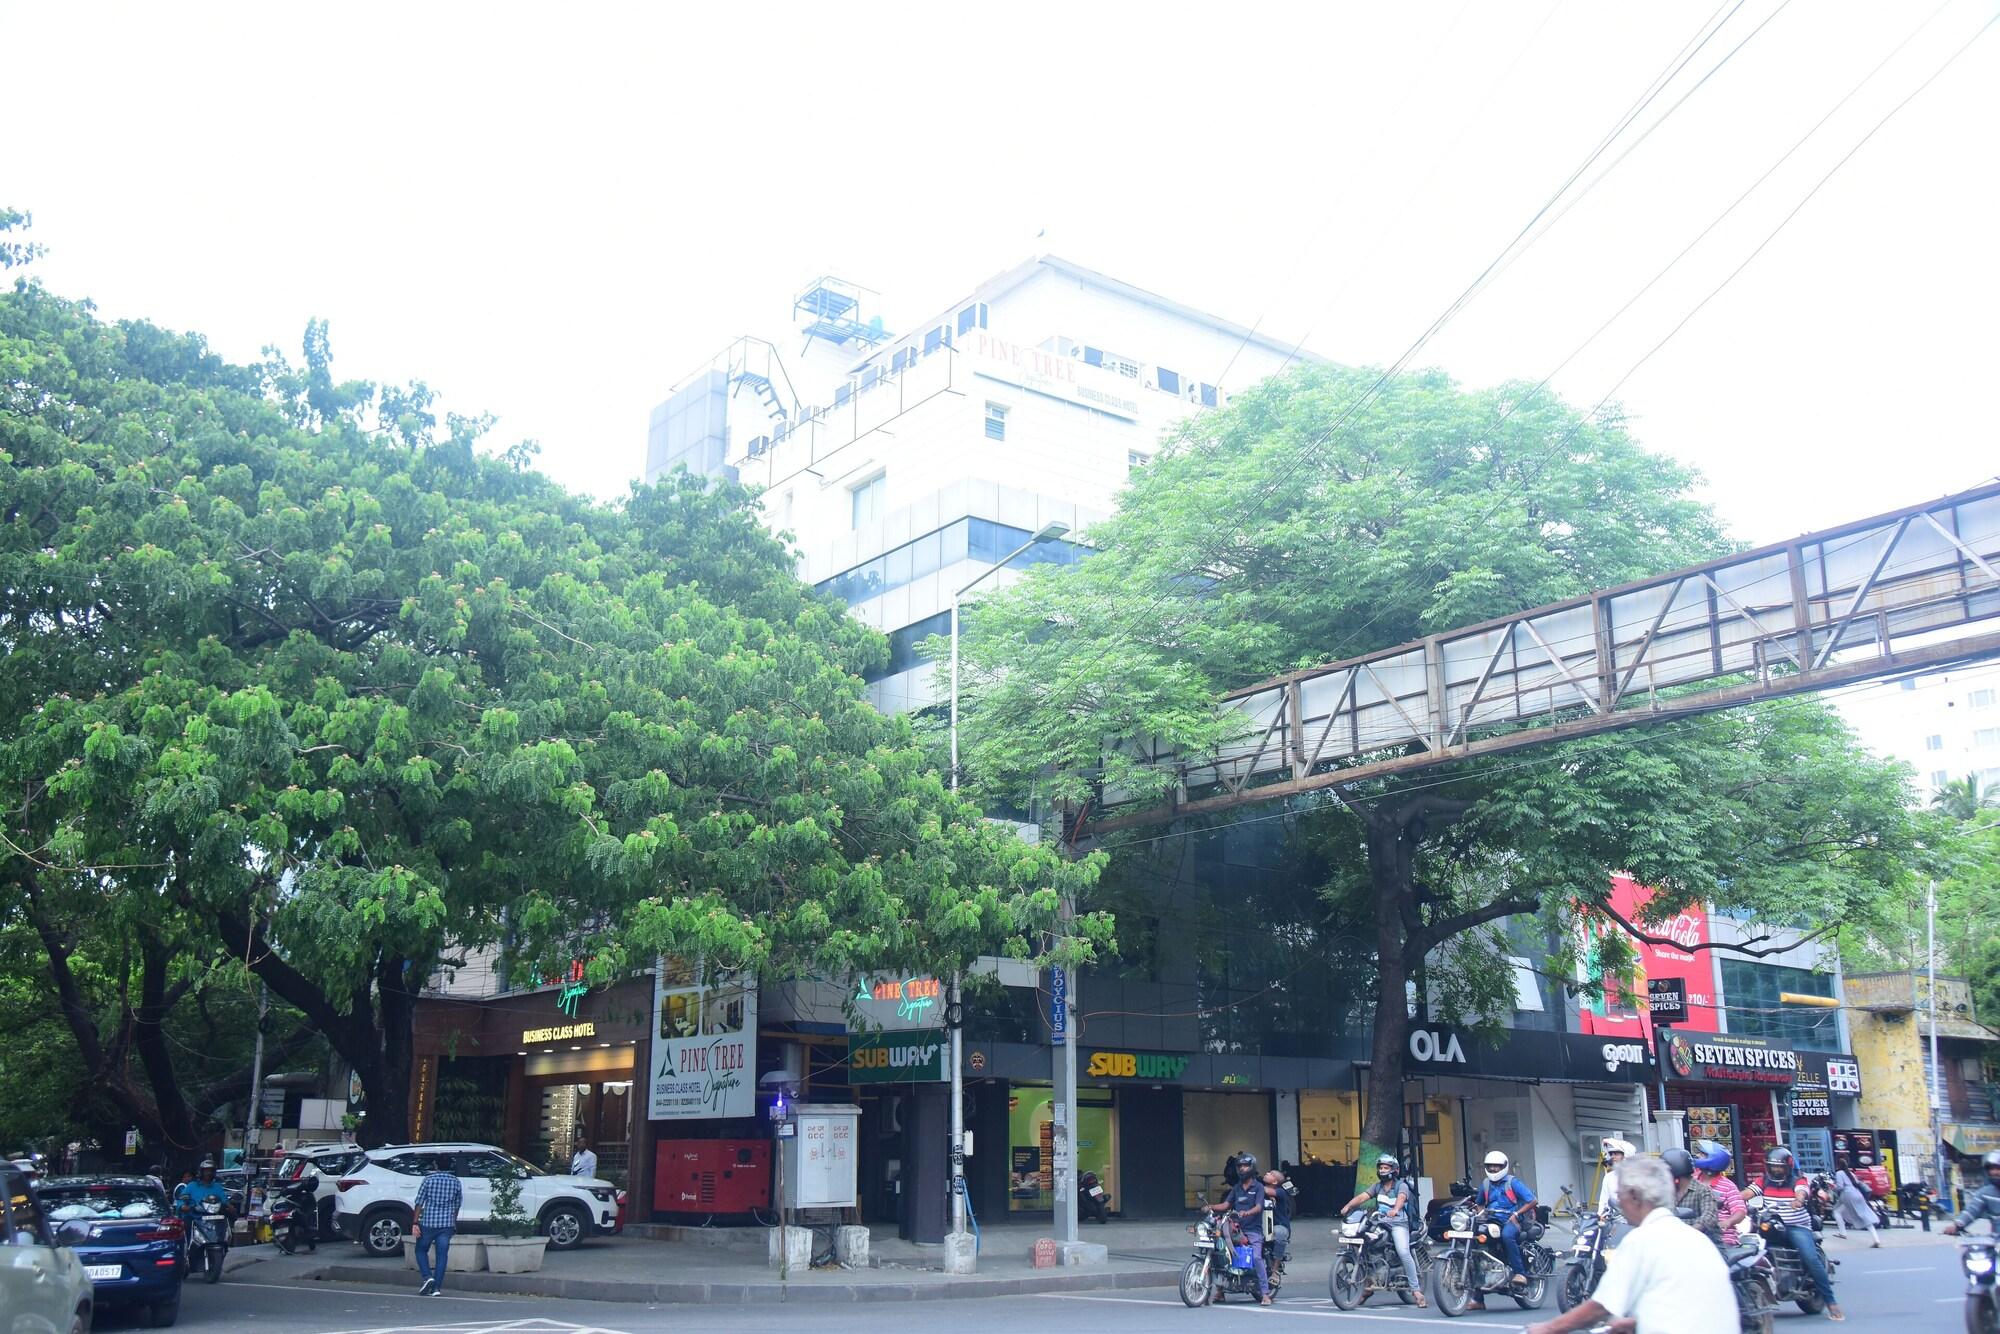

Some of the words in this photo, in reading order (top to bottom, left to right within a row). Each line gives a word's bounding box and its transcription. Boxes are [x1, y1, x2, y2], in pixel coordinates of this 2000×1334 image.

[978, 333, 1020, 368] PINE
[1031, 350, 1076, 384] TREE
[1670, 952, 1679, 960] the
[907, 977, 939, 998] TREE
[1649, 992, 1679, 1002] SEVEN
[1649, 1001, 1681, 1012] SPICES
[522, 1027, 553, 1044] BUSINESS
[552, 1025, 574, 1041] CLASS
[573, 1021, 596, 1037] HOTEL
[851, 1043, 939, 1068] SUBWAY
[1410, 1029, 1467, 1063] OLA
[1694, 1043, 1745, 1066] SEVEN
[1745, 1047, 1796, 1070] SPICES
[680, 1047, 707, 1073] PINE
[714, 1043, 744, 1071] TREE
[1086, 1052, 1189, 1079] SUBWAY
[1796, 1071, 1821, 1083] ZELLE
[656, 1082, 675, 1095] BUSINESS
[675, 1082, 688, 1094] CLASS
[688, 1081, 702, 1093] HOTEL
[1791, 1098, 1828, 1108] SEVEN
[1792, 1107, 1831, 1117] SPICES
